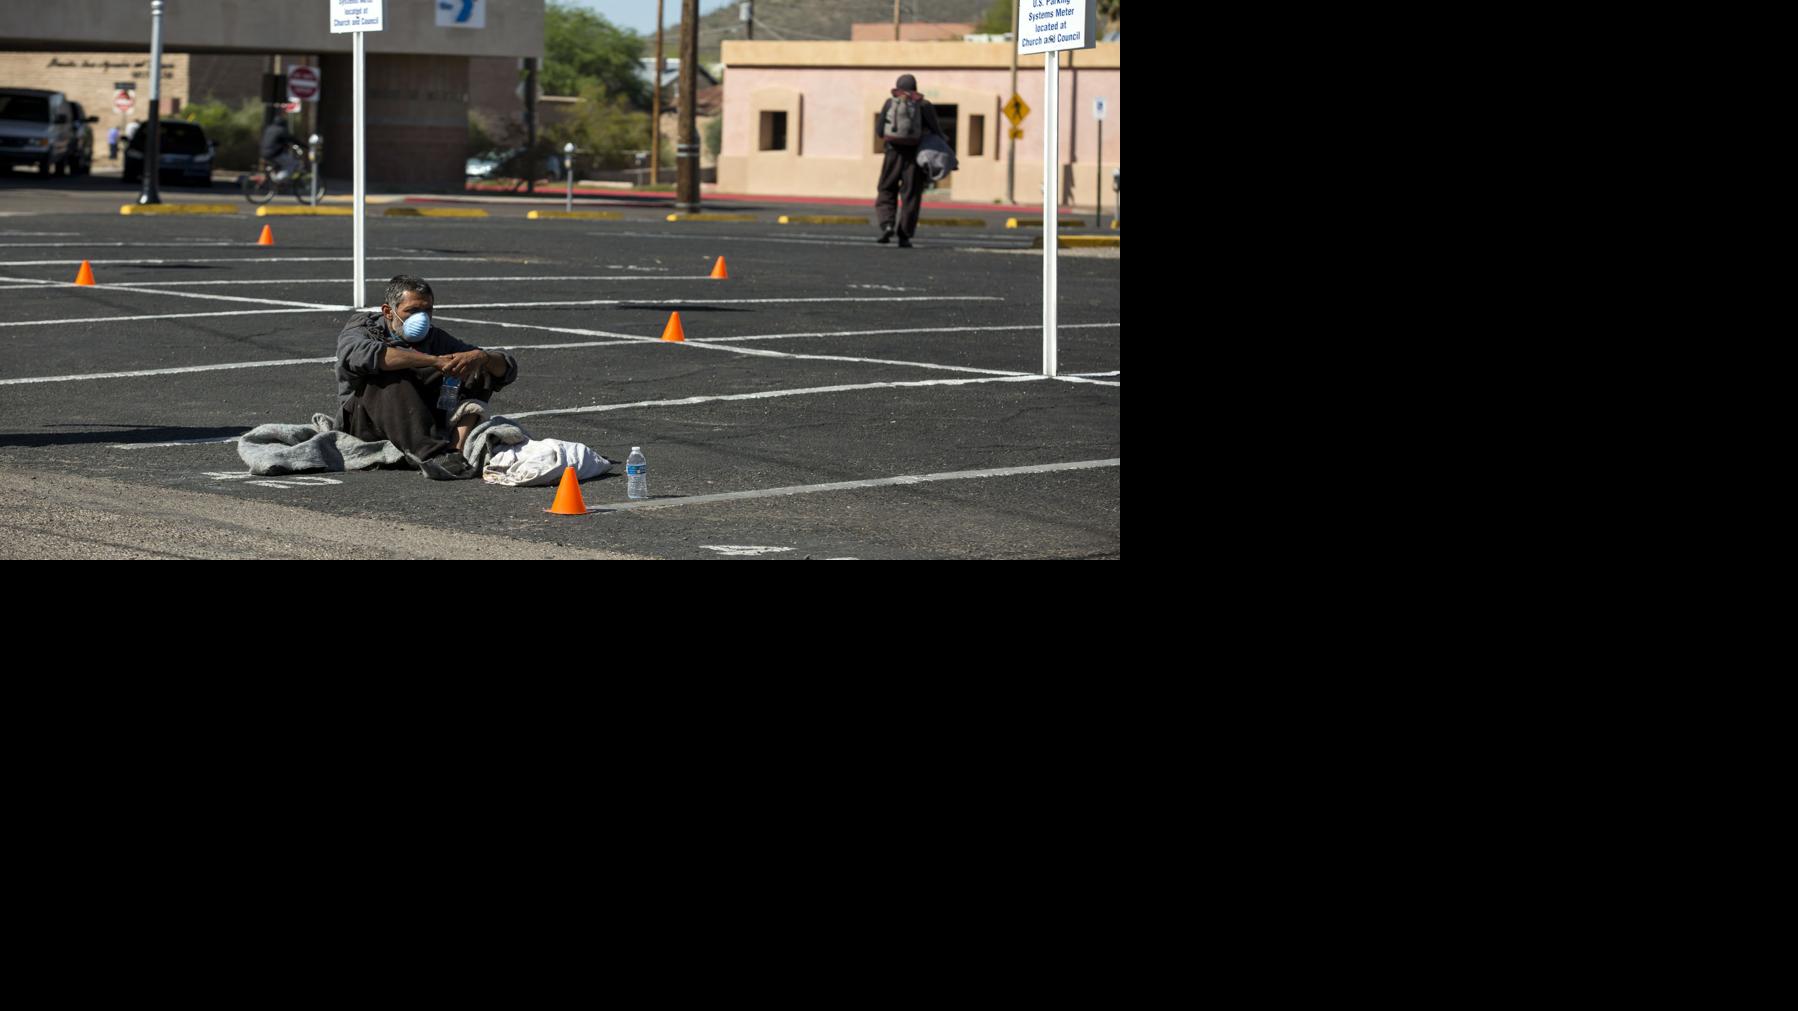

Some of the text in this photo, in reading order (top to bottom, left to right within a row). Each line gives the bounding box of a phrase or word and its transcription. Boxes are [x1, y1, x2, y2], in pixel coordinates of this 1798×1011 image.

[1032, 0, 1044, 8] U.S.
[1028, 8, 1075, 22] Systems Meter
[1035, 21, 1067, 33] located at
[1021, 37, 1043, 47] Church
[1057, 31, 1081, 43] Council
